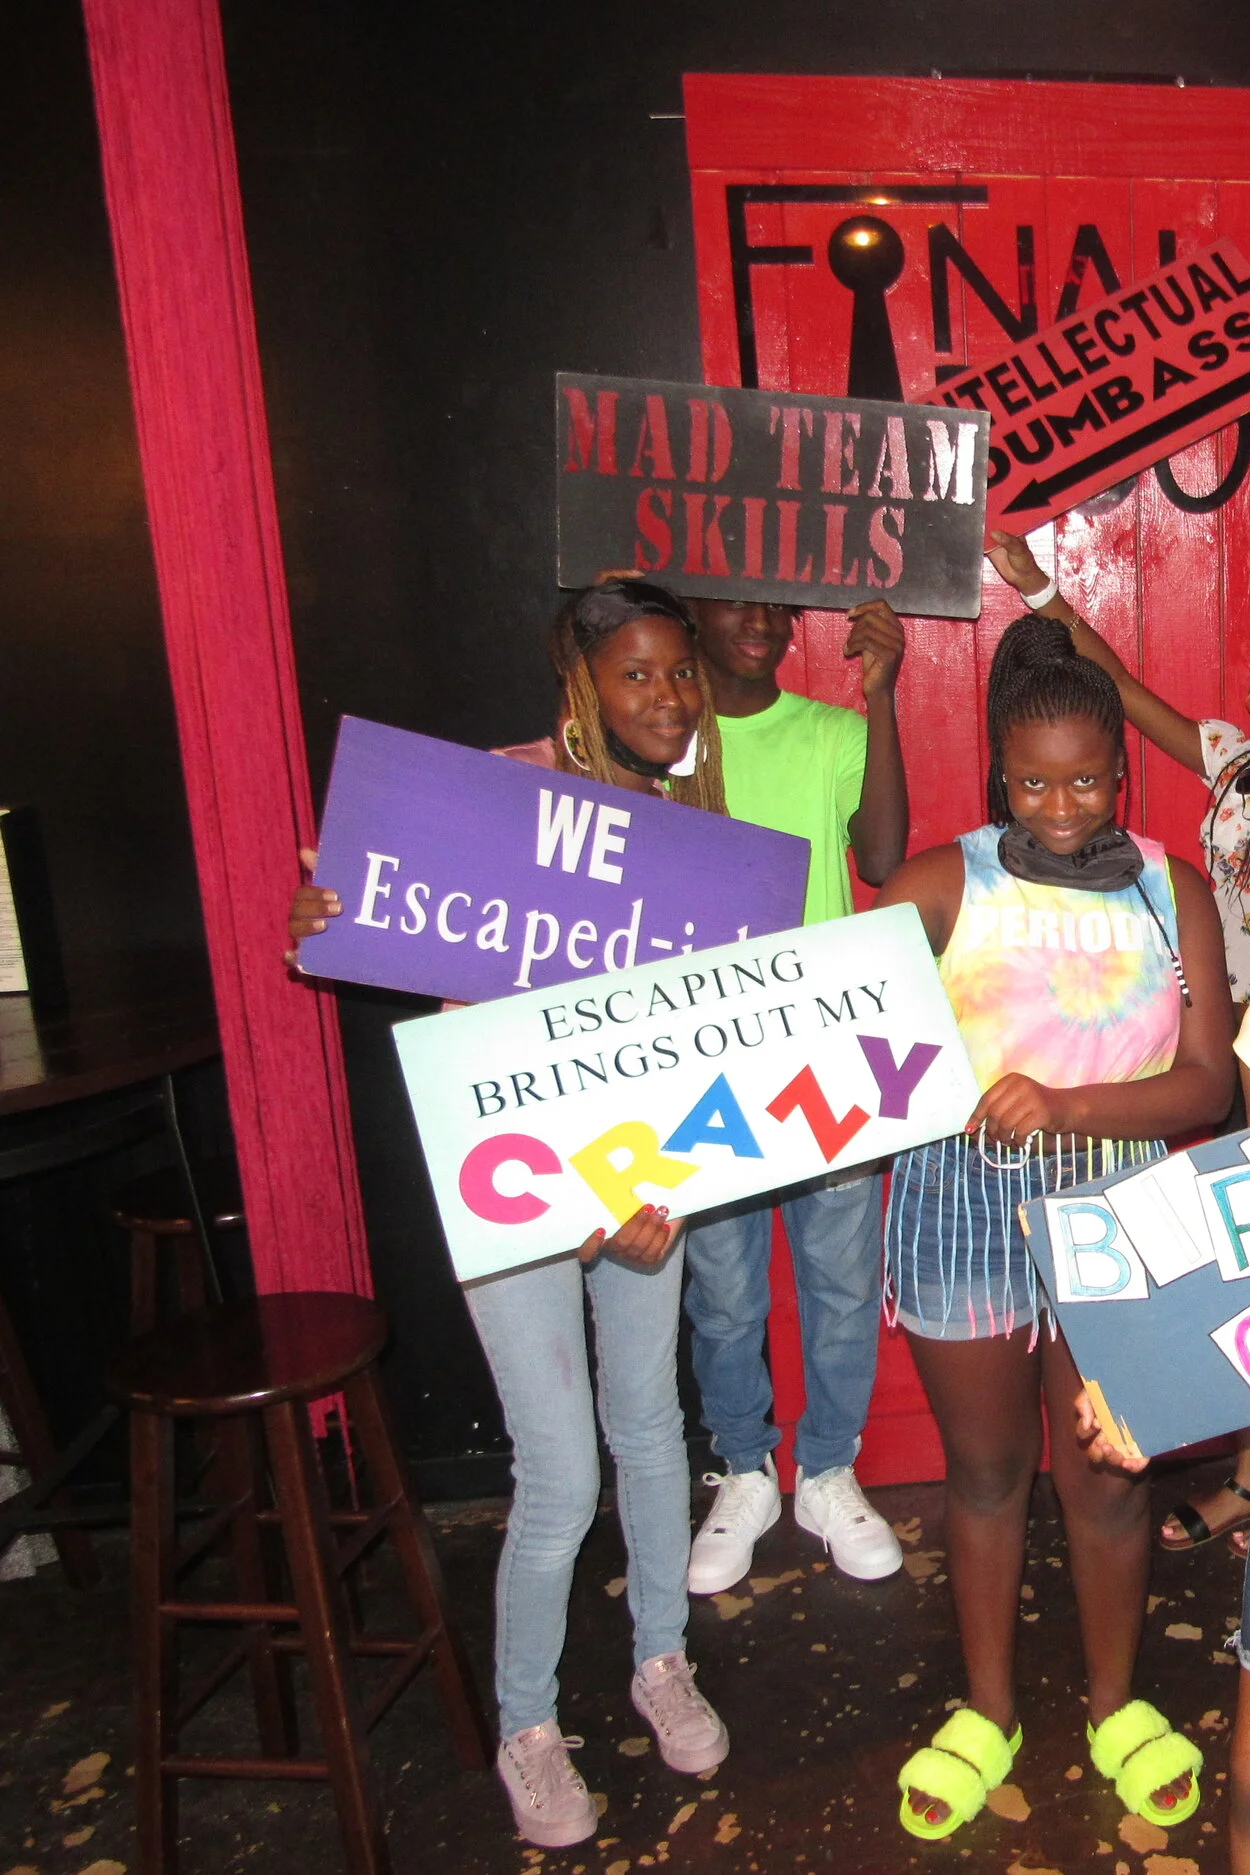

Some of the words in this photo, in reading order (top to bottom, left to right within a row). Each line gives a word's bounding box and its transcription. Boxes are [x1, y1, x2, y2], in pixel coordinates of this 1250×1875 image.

[563, 387, 734, 483] MAD
[769, 405, 979, 504] TEAM
[633, 487, 905, 588] SKILLS
[535, 788, 632, 885] WE
[470, 1035, 681, 1119] BRINGS
[693, 1004, 798, 1058] OUT
[814, 980, 890, 1029] MY
[539, 949, 806, 1042] ESCAPING
[459, 1034, 943, 1226] CRAZY
